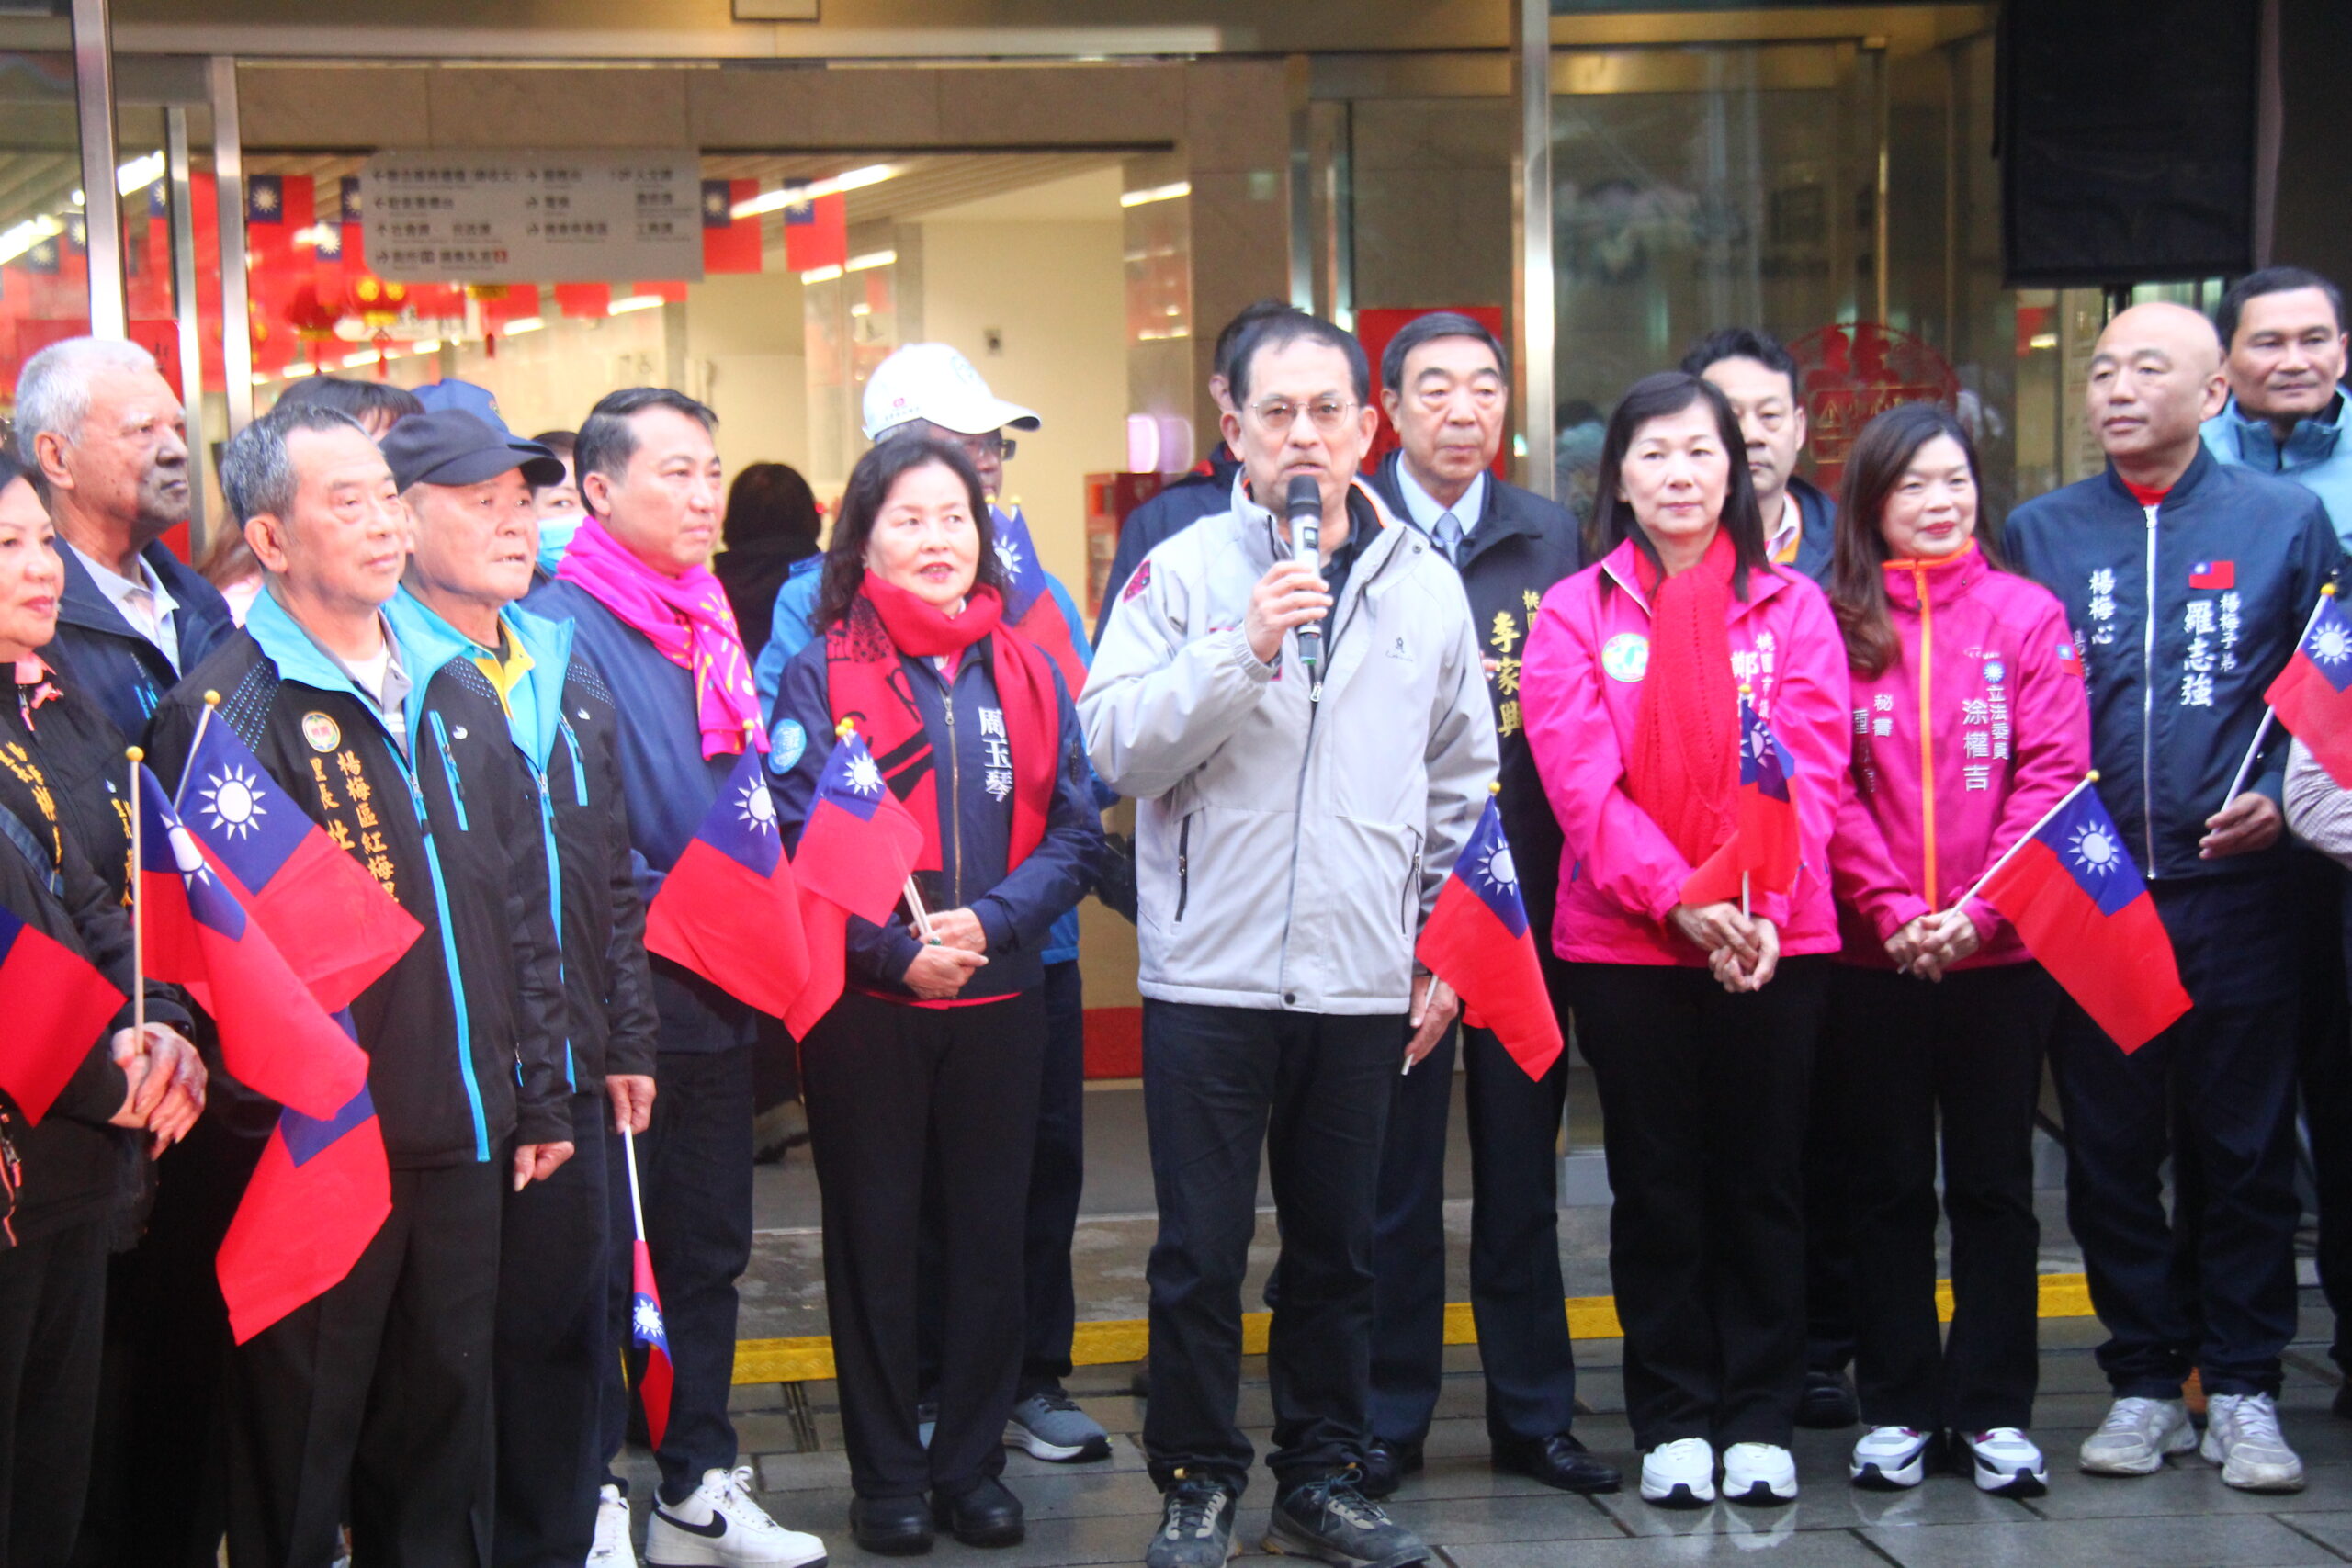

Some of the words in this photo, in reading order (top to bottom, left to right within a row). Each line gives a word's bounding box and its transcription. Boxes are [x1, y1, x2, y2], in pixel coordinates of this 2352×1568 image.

[2089, 567, 2116, 644] 楊梅心
[2220, 591, 2242, 672] 楊梅子弟
[2181, 599, 2216, 707] 羅志強
[978, 706, 1012, 803] 周玉琴
[1872, 694, 1894, 737] 秘書
[1962, 699, 1991, 792] 涂權吉
[1985, 684, 2010, 761] 立法委員
[310, 756, 340, 810] 里長
